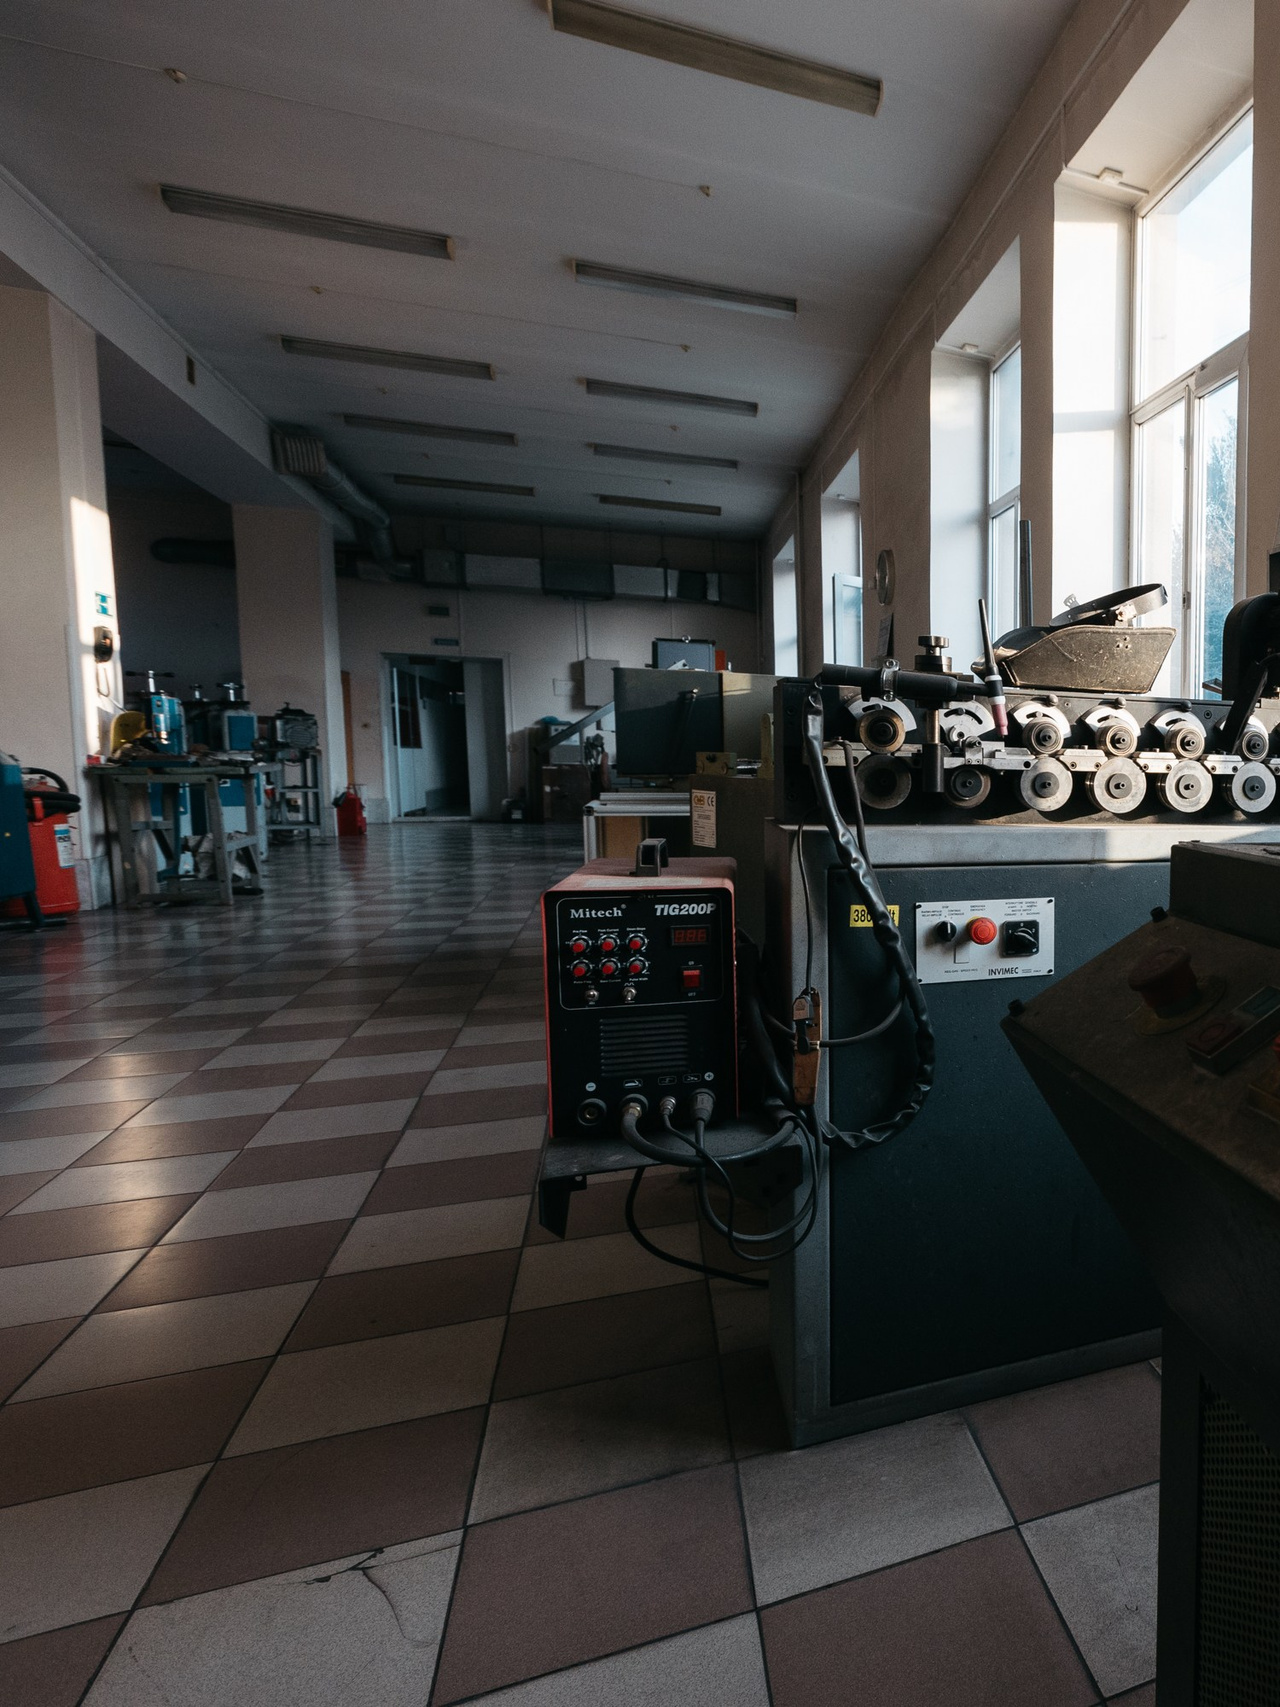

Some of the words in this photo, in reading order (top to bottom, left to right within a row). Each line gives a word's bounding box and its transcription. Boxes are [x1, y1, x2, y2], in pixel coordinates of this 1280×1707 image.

[707, 796, 714, 807] CE
[570, 907, 623, 918] Mitech
[654, 903, 716, 916] TIG200P
[988, 967, 1019, 976] INVIMEC
